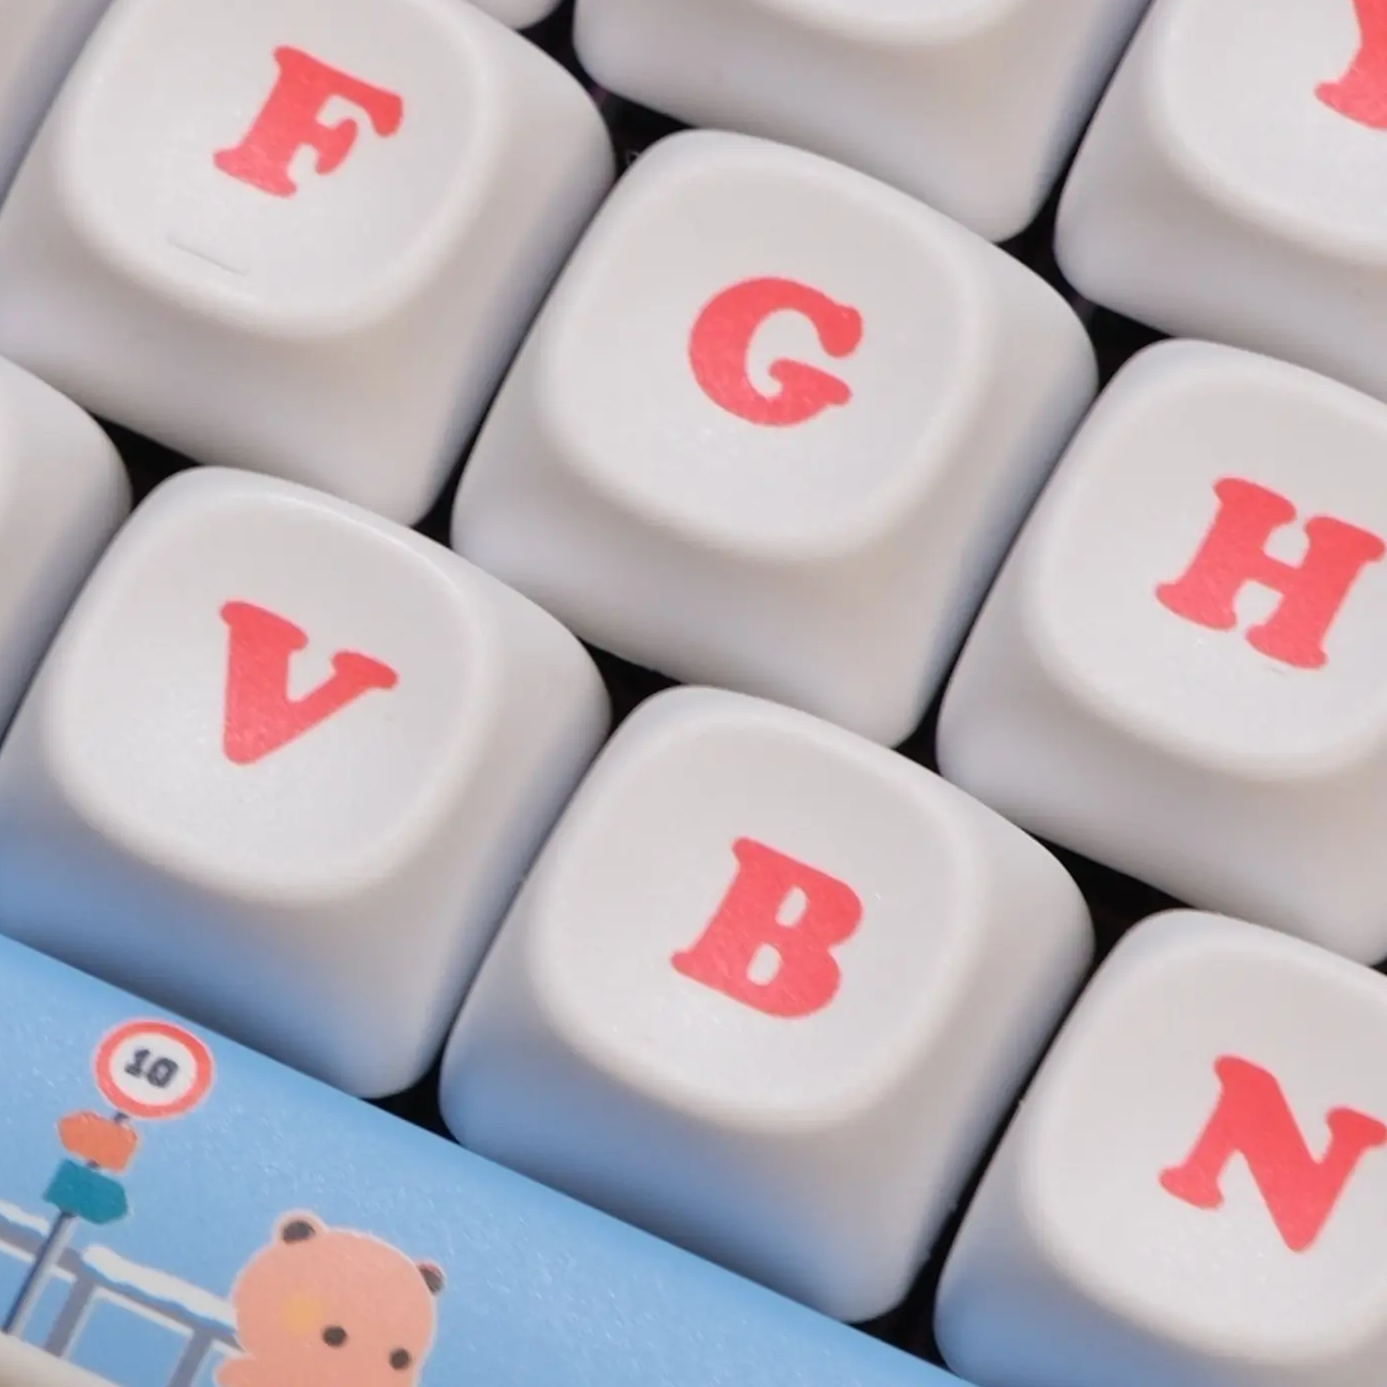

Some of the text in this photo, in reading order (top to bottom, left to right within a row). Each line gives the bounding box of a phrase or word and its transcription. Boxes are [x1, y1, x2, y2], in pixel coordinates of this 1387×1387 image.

[213, 45, 405, 197] F
[687, 275, 865, 427] G
[1155, 475, 1386, 670] H
[219, 598, 399, 765] V
[670, 836, 864, 1019] B
[124, 1048, 179, 1088] 10
[1157, 1053, 1387, 1252] N
